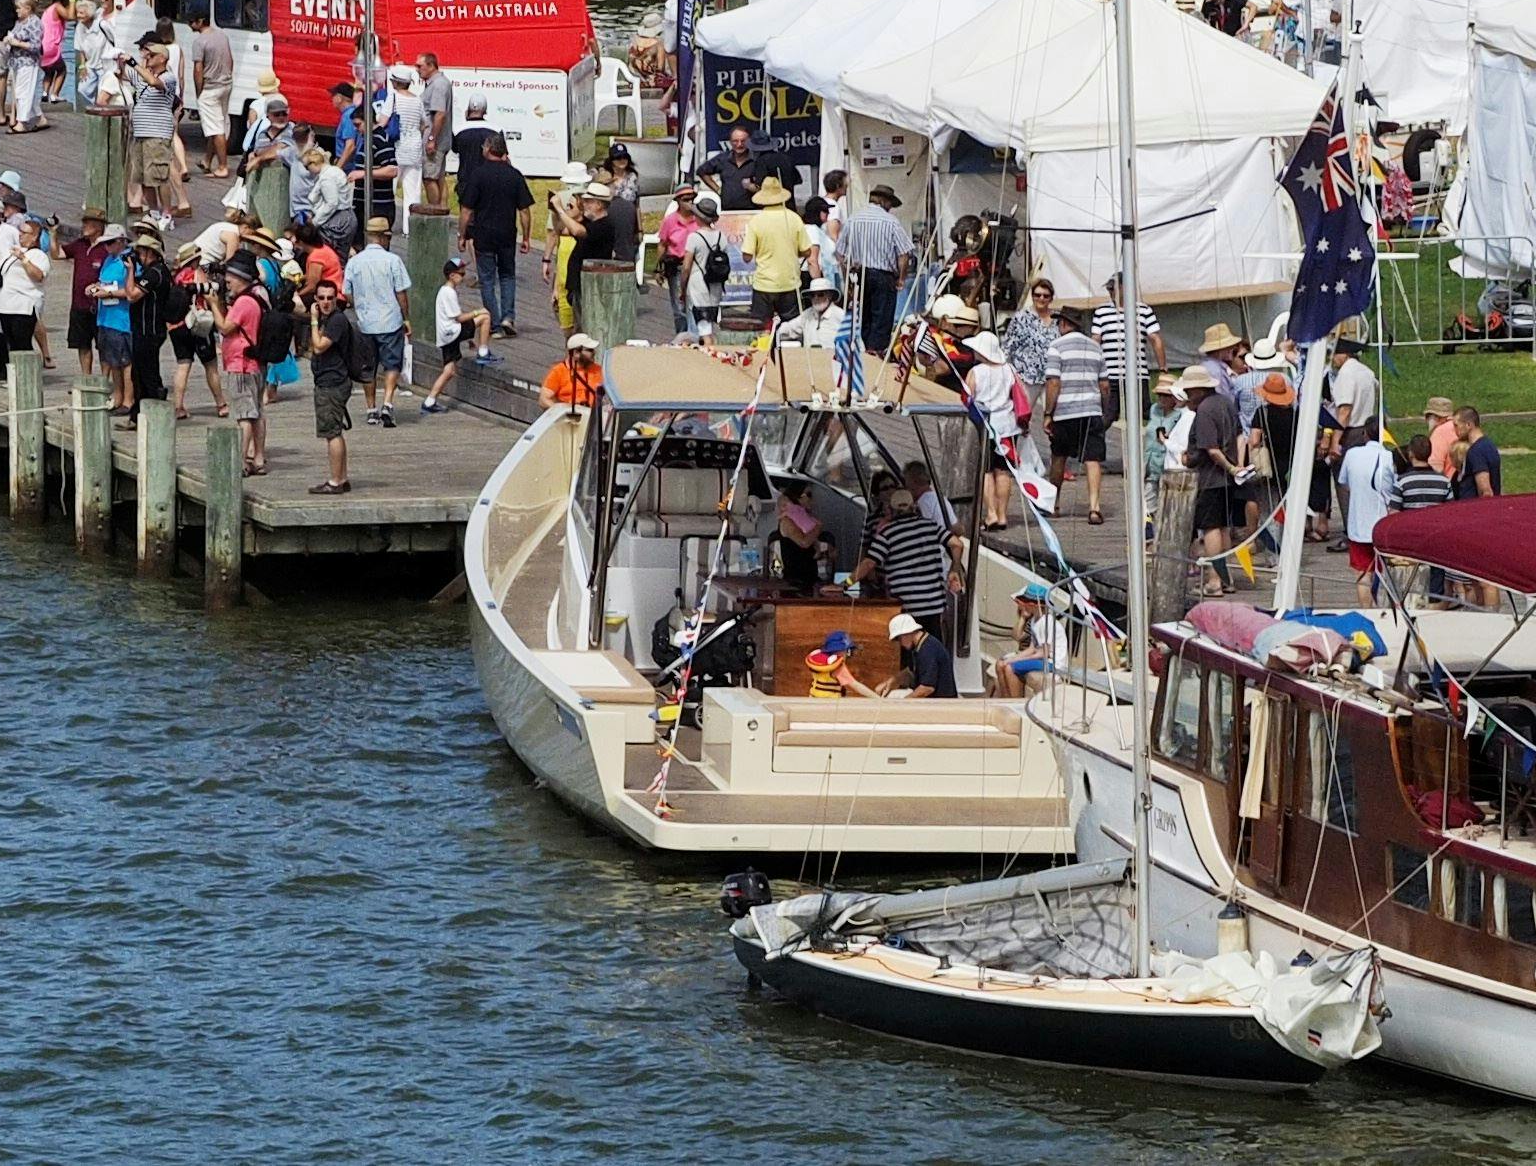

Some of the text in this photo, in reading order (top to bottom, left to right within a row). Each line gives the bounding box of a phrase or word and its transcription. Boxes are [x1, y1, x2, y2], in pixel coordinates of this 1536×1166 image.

[415, 1, 558, 22] SOUTH AUSTRALIA
[290, 18, 319, 35] SOUTH
[681, 32, 693, 47] PJ
[463, 81, 478, 89] our
[481, 80, 515, 90] Festival
[518, 80, 560, 92] Sponsors
[716, 70, 736, 89] PJ
